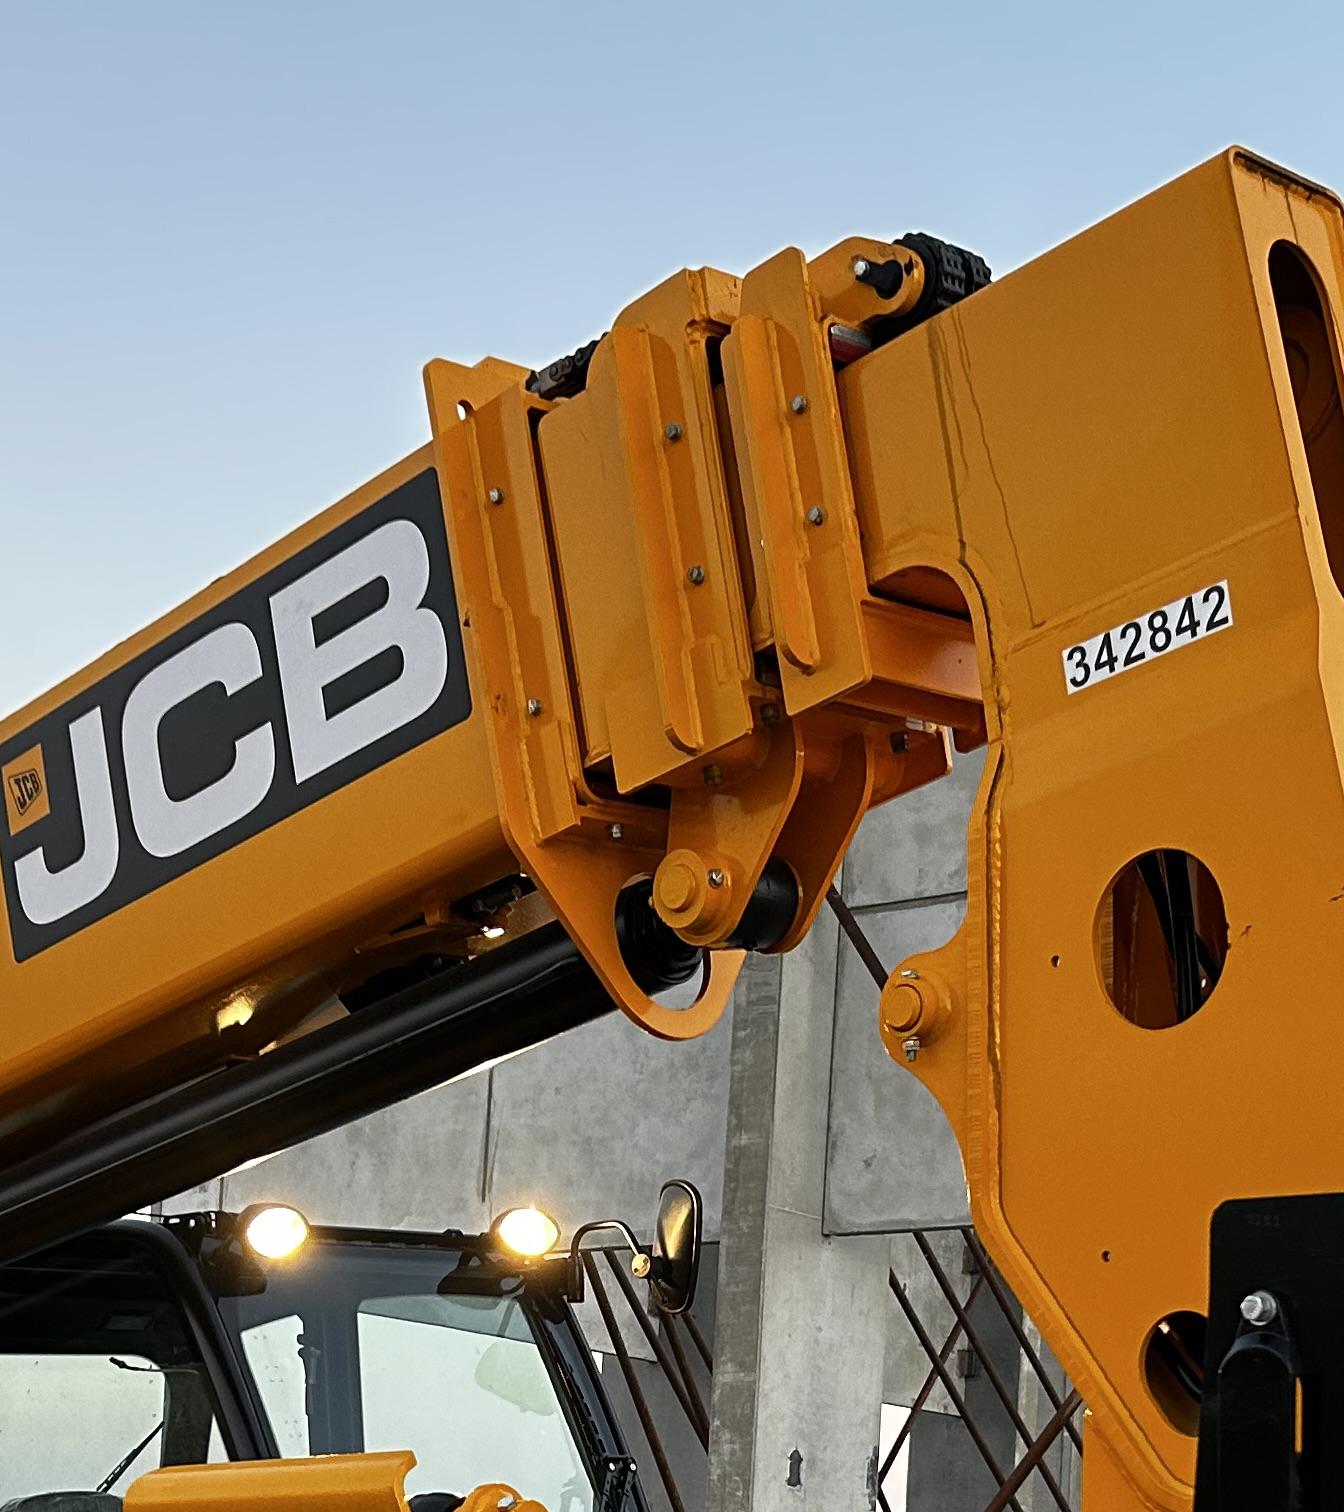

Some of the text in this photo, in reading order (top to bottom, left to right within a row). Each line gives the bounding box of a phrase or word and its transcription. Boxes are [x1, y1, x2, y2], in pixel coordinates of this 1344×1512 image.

[1066, 584, 1230, 688] 342842
[14, 519, 448, 925] JCB
[13, 772, 40, 810] JCB
